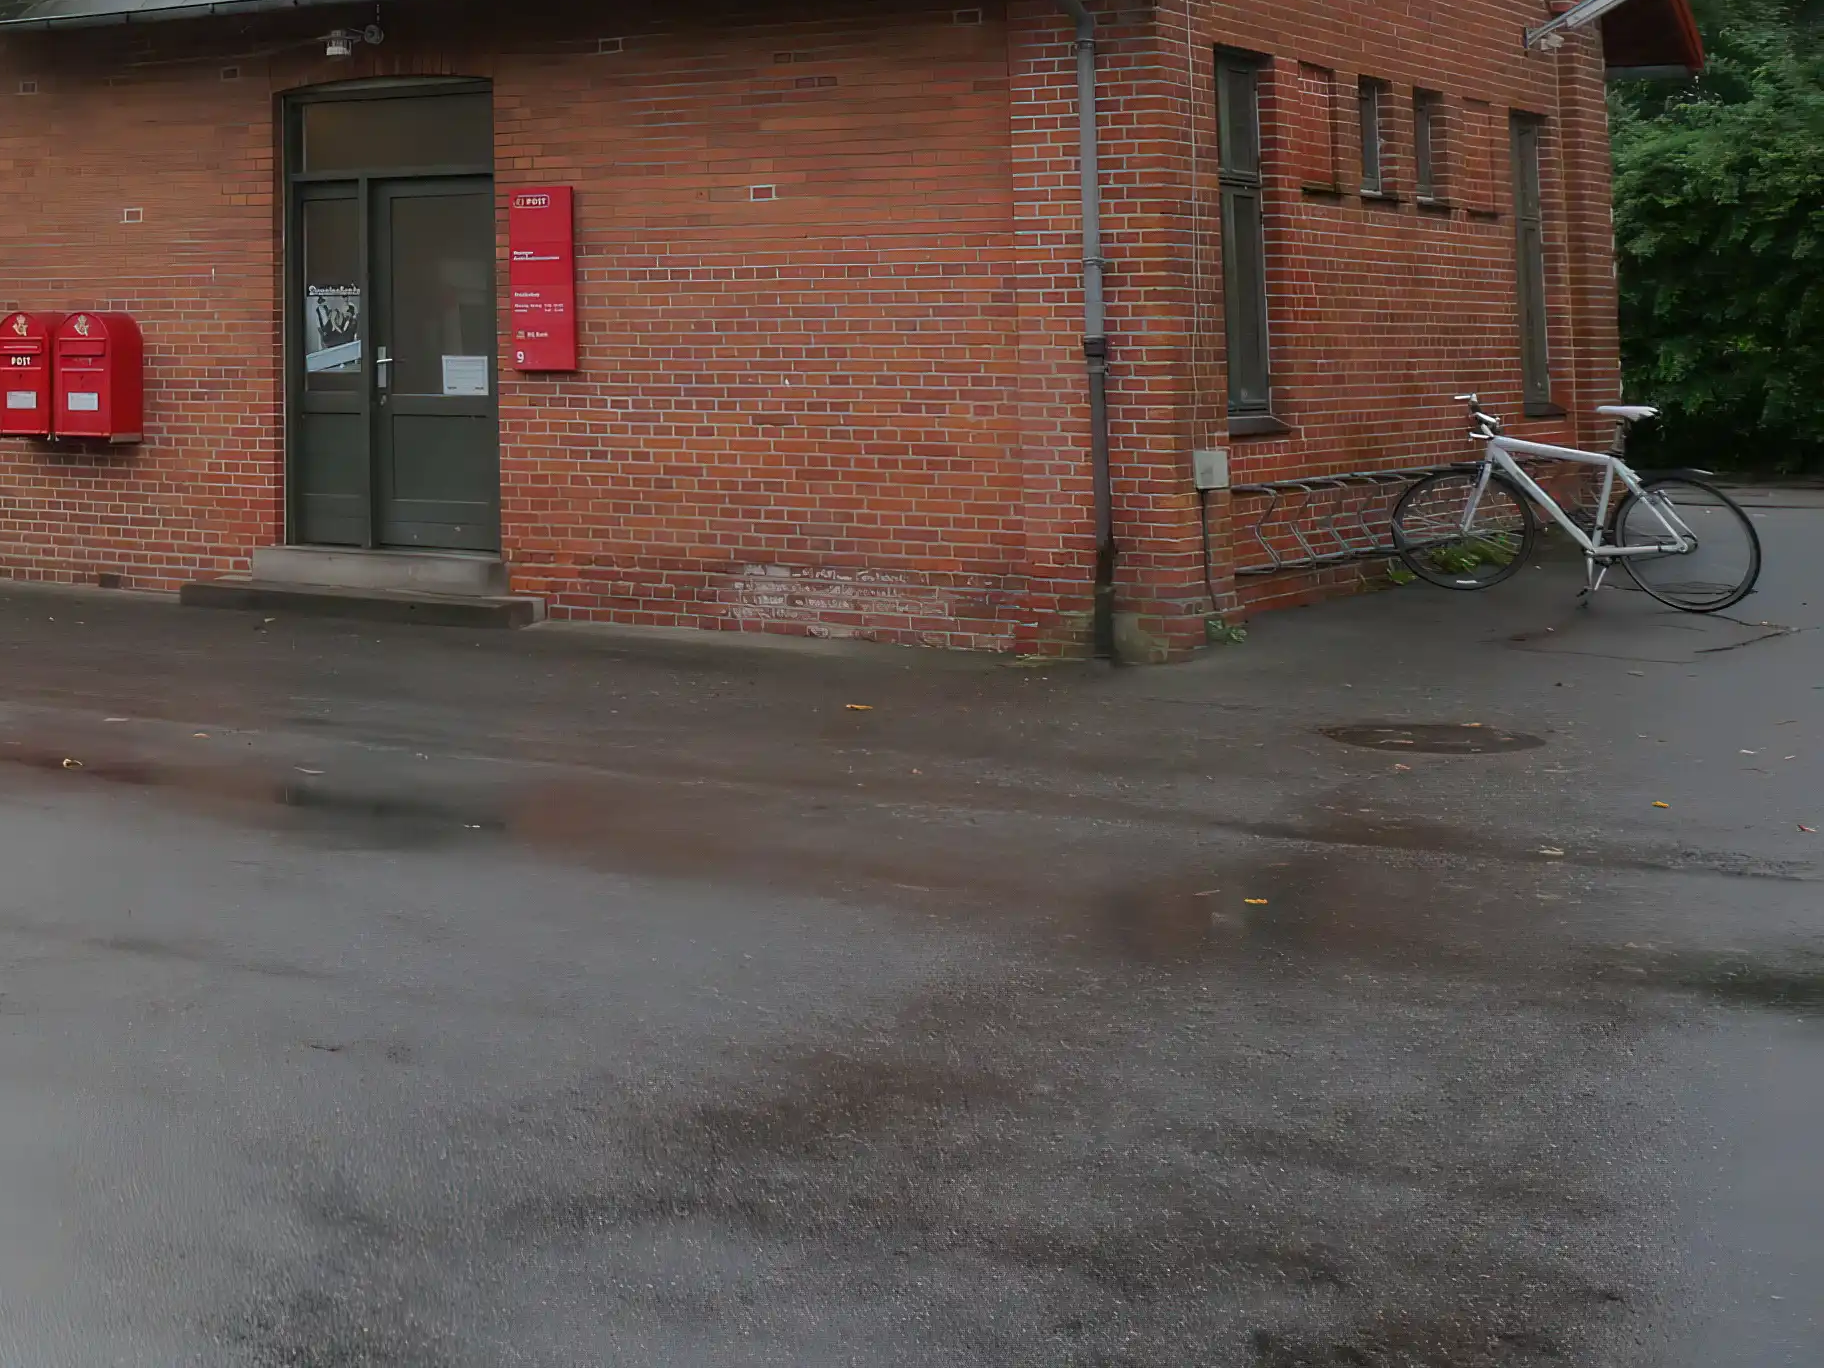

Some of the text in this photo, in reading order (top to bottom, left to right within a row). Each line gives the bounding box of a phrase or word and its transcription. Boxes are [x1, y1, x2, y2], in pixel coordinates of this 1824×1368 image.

[526, 197, 546, 206] POST
[11, 356, 31, 366] POST
[516, 351, 525, 363] 9
